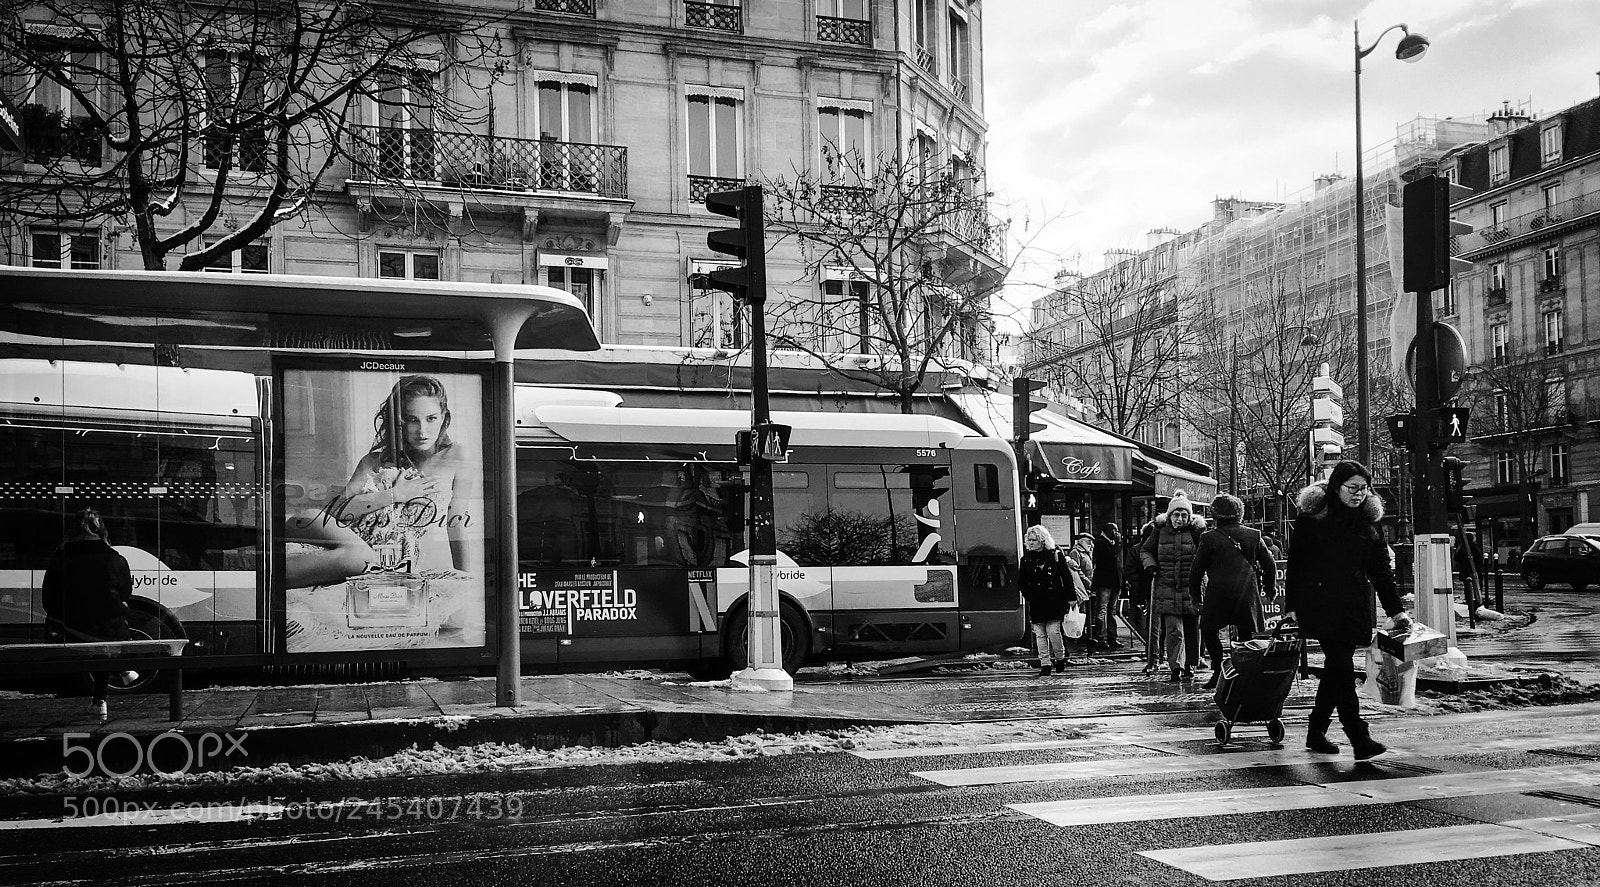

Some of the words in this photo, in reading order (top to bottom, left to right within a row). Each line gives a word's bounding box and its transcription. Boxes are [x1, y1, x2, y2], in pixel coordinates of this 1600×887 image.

[360, 361, 406, 371] JCDecaux
[916, 449, 936, 457] 5576
[296, 494, 390, 528] Miss
[393, 496, 474, 528] Dior
[687, 570, 713, 579] NETFLIX
[776, 570, 806, 580] bride
[517, 572, 537, 588] HE
[576, 607, 638, 621] PARADOX
